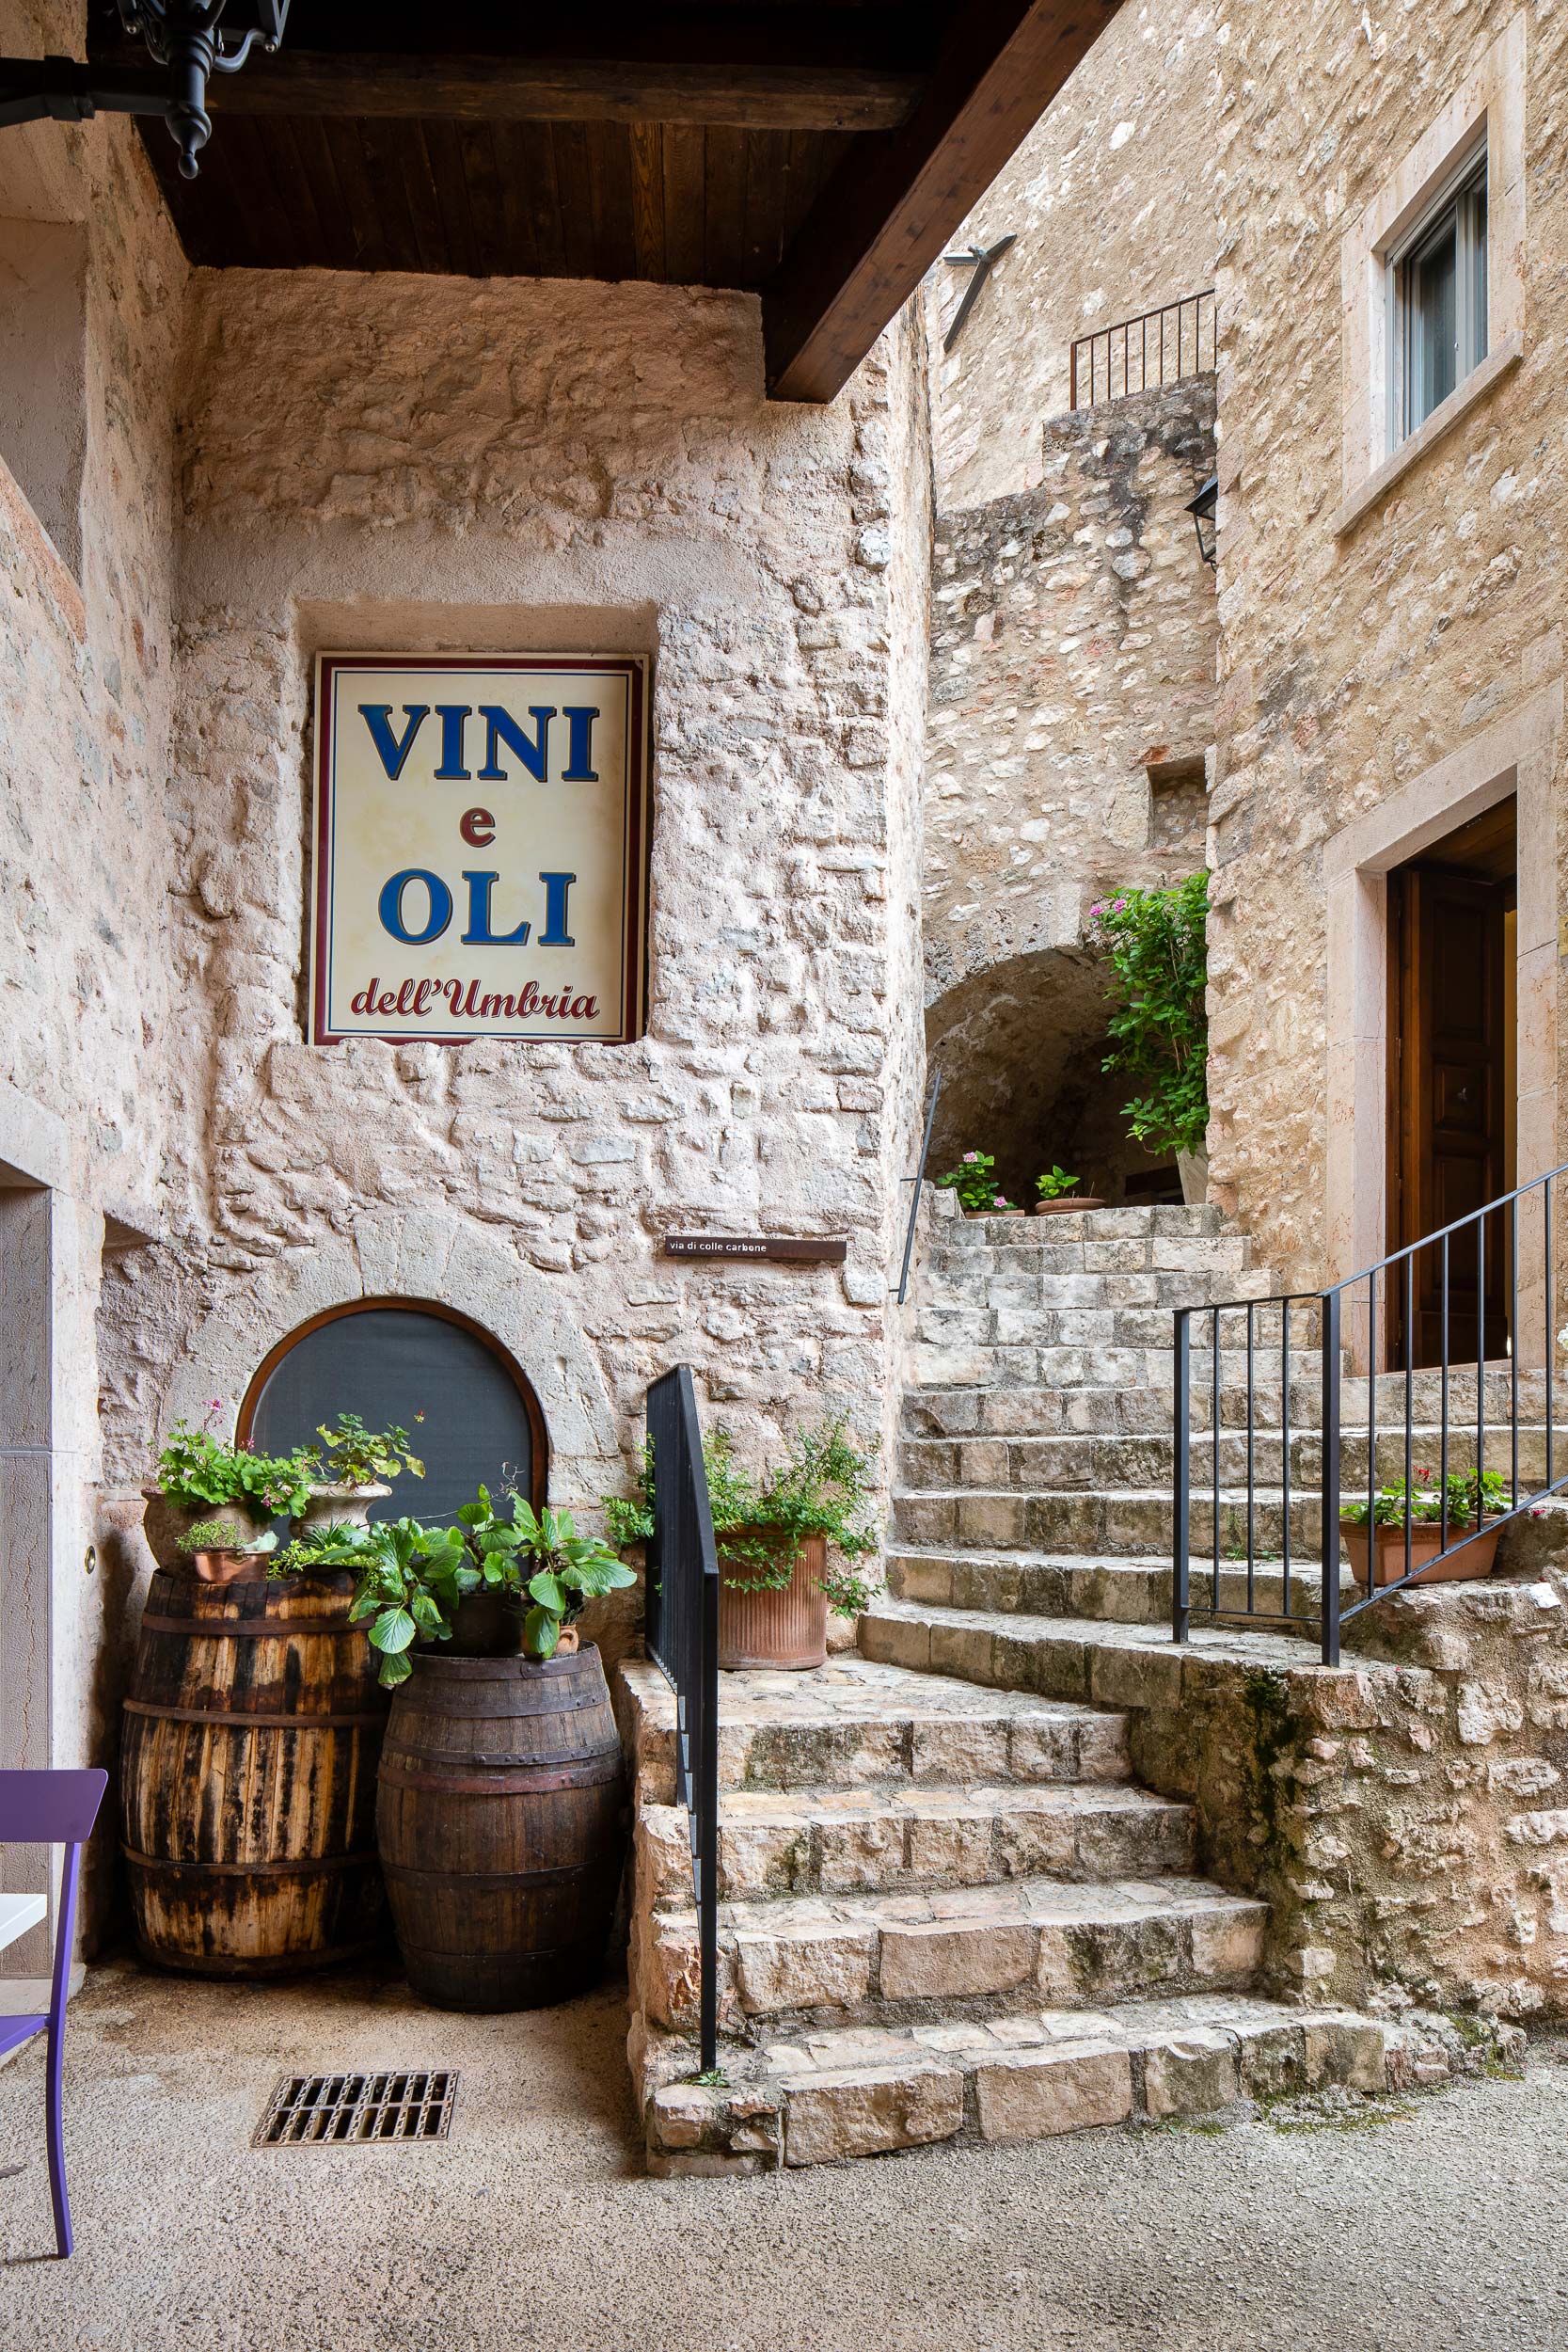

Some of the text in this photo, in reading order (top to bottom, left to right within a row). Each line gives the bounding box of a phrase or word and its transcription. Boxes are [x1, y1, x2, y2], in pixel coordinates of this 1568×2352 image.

[357, 704, 600, 782] VINI
[460, 807, 496, 848] e
[378, 868, 577, 946] OLI
[351, 977, 600, 1019] dell'Umbria
[670, 1241, 767, 1252] via di colle carbone
